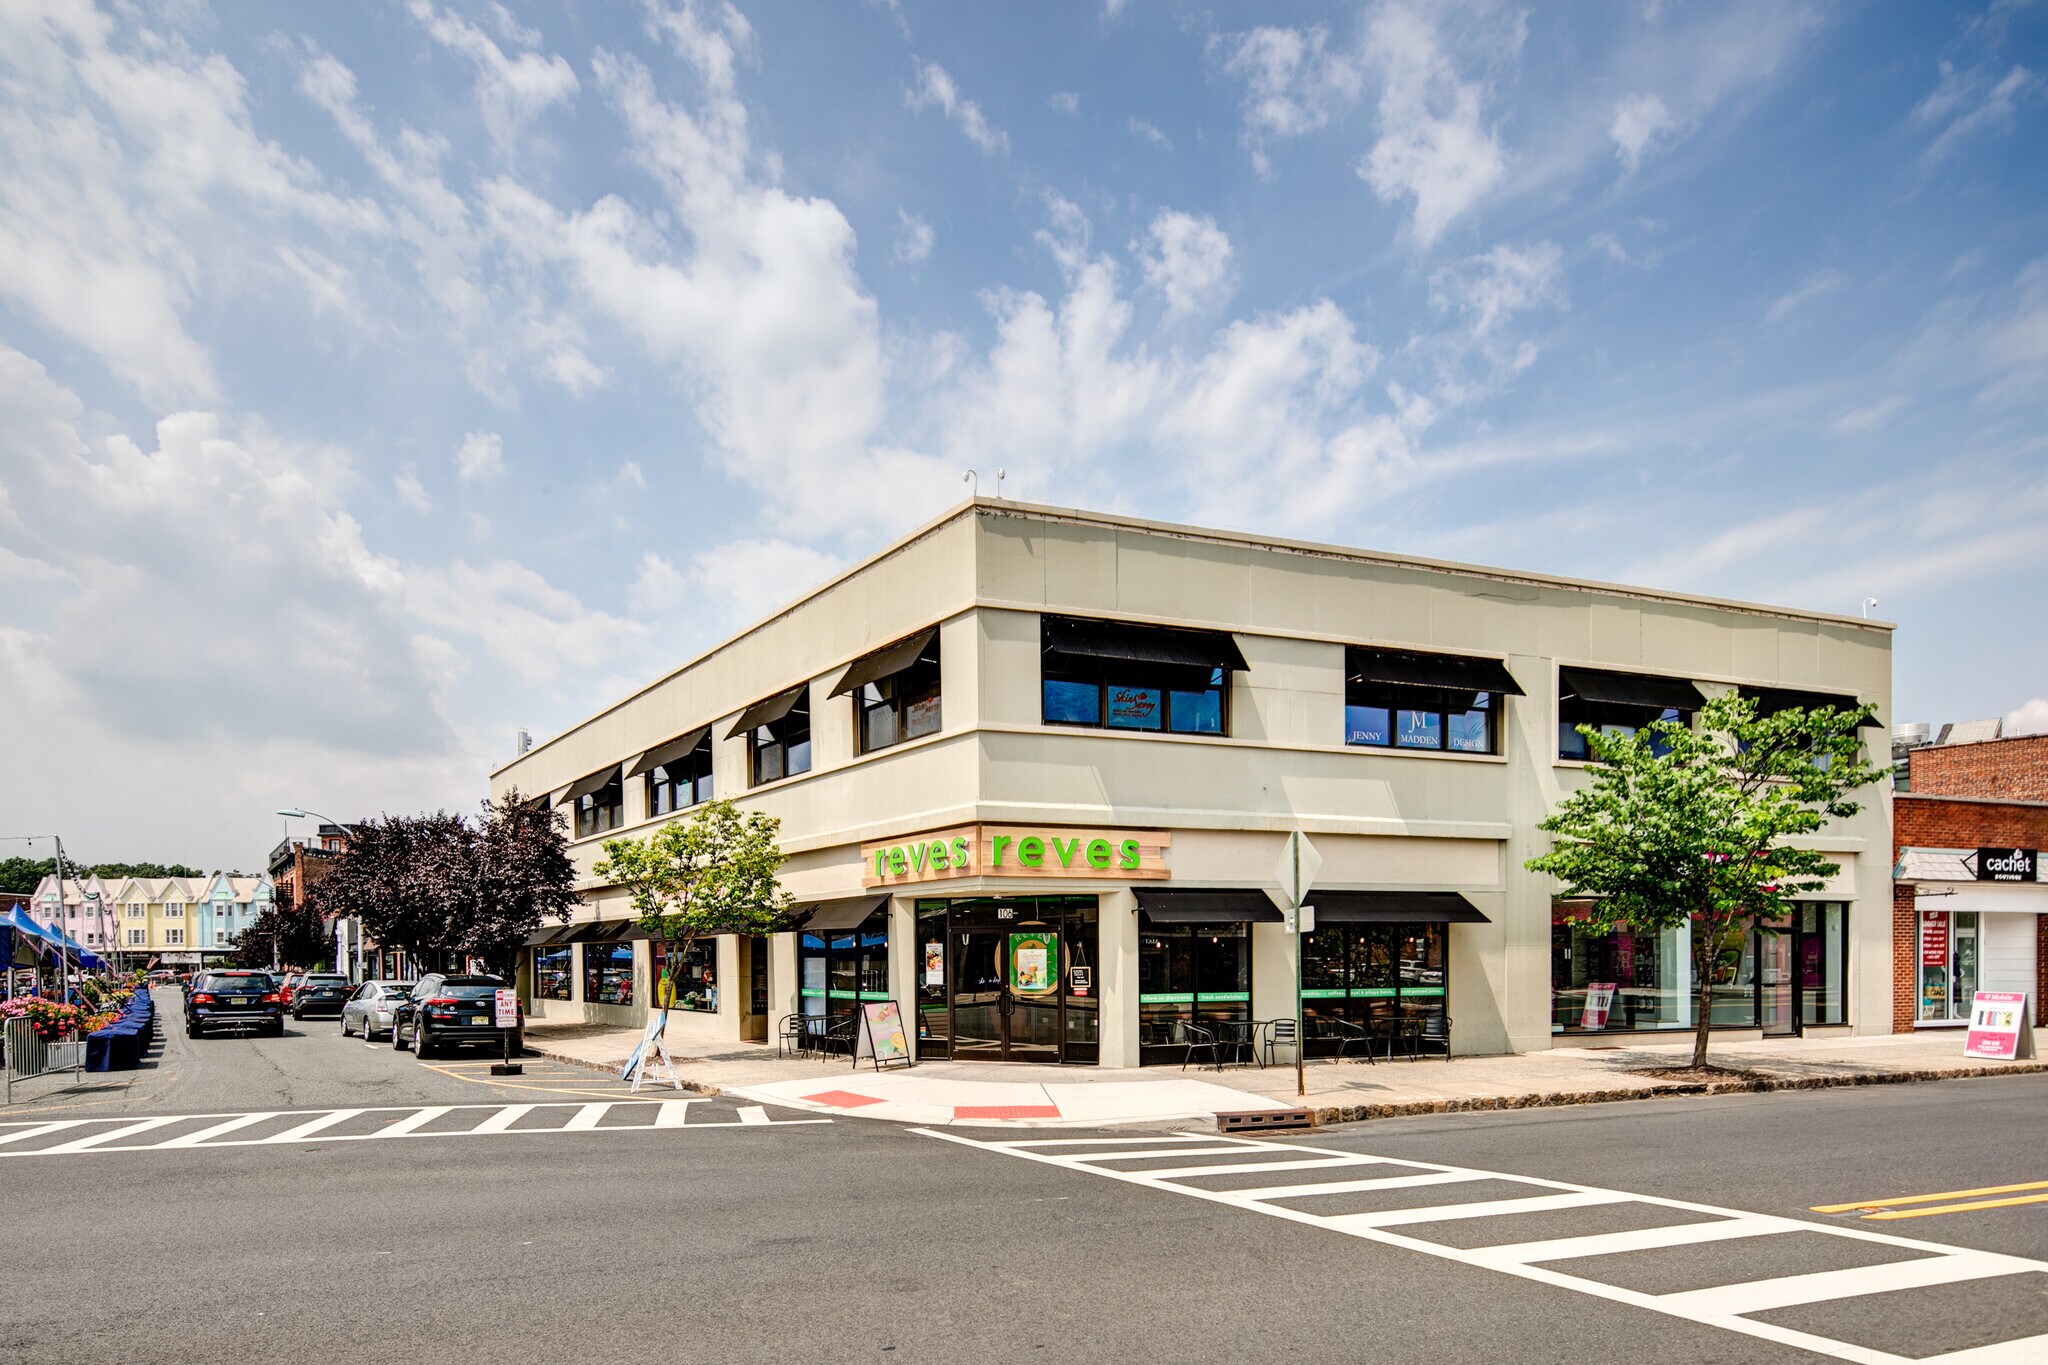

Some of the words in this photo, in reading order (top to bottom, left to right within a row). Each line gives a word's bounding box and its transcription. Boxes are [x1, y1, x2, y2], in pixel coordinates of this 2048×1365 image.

[1352, 731, 1382, 742] JENNY
[1400, 734, 1438, 745] MADDEN
[1453, 738, 1483, 749] DESIGN
[875, 836, 969, 877] reves
[992, 836, 1141, 870] reves
[1986, 855, 2031, 872] cachet
[998, 909, 1013, 919] 106
